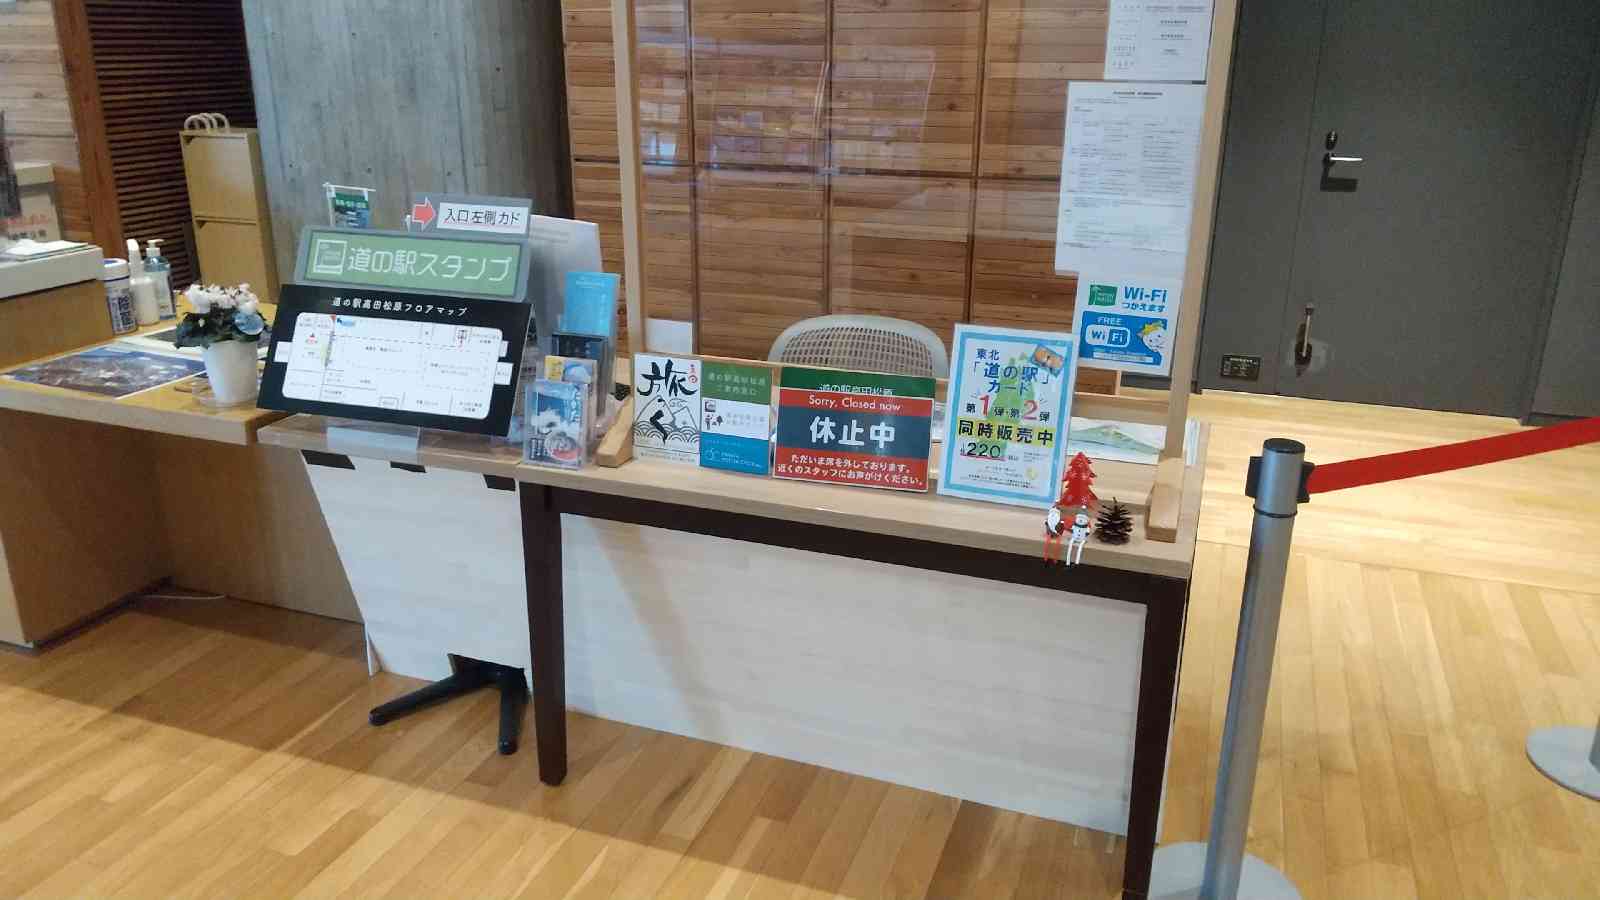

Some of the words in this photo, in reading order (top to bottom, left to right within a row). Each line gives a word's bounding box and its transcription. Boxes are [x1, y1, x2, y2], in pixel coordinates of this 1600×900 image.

[346, 247, 513, 281] 道の駅スタンプ
[1123, 286, 1167, 303] Wi-Fi
[332, 296, 468, 316] 道の駅高田松原フロアマップ
[1121, 302, 1166, 312] つかえます
[1097, 316, 1124, 326] FREE
[976, 348, 1000, 361] 東北
[974, 361, 1049, 384] 「道の駅」
[987, 379, 1030, 396] カード
[841, 396, 876, 410] Closed
[879, 402, 902, 411] now
[809, 415, 895, 449] 休止中
[958, 419, 1053, 446] 同時販売中
[791, 454, 911, 474] ただいま席を外しております。
[777, 463, 923, 486] 近くのスタッフにお声がけください。
